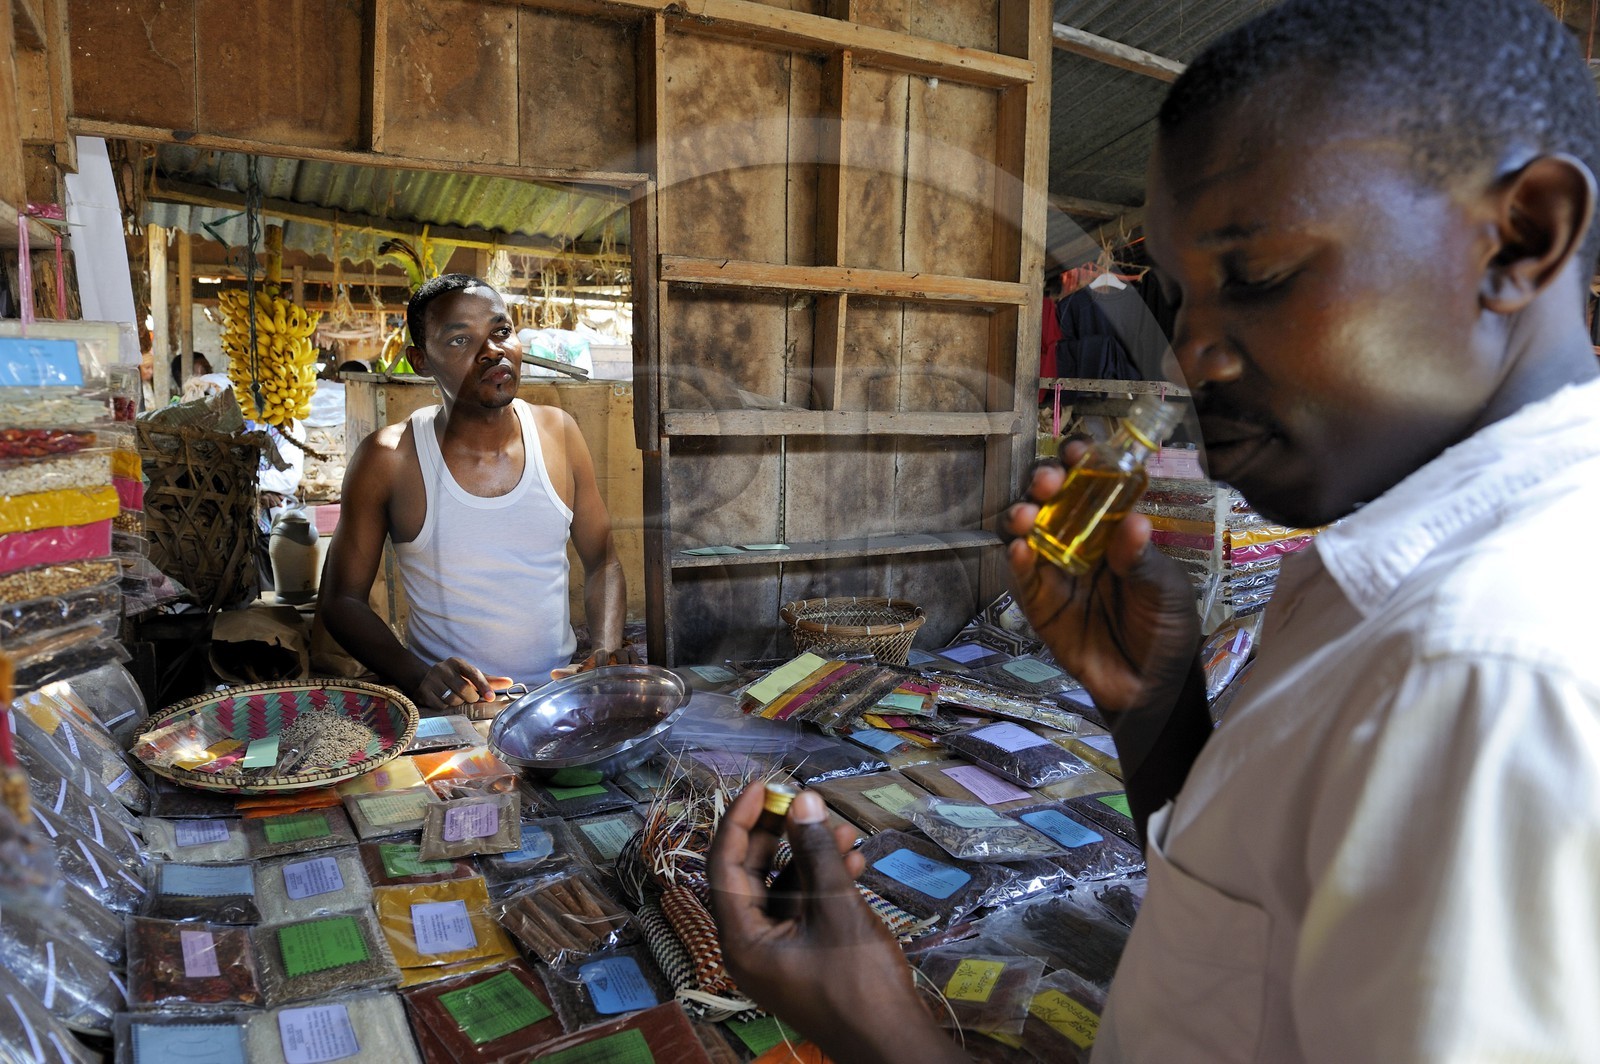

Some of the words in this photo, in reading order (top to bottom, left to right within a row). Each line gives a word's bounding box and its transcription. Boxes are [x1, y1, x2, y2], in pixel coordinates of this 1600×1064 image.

[955, 980, 972, 998] PURE
[1052, 997, 1100, 1028] SAFFRON
[1069, 1020, 1096, 1042] PURE
